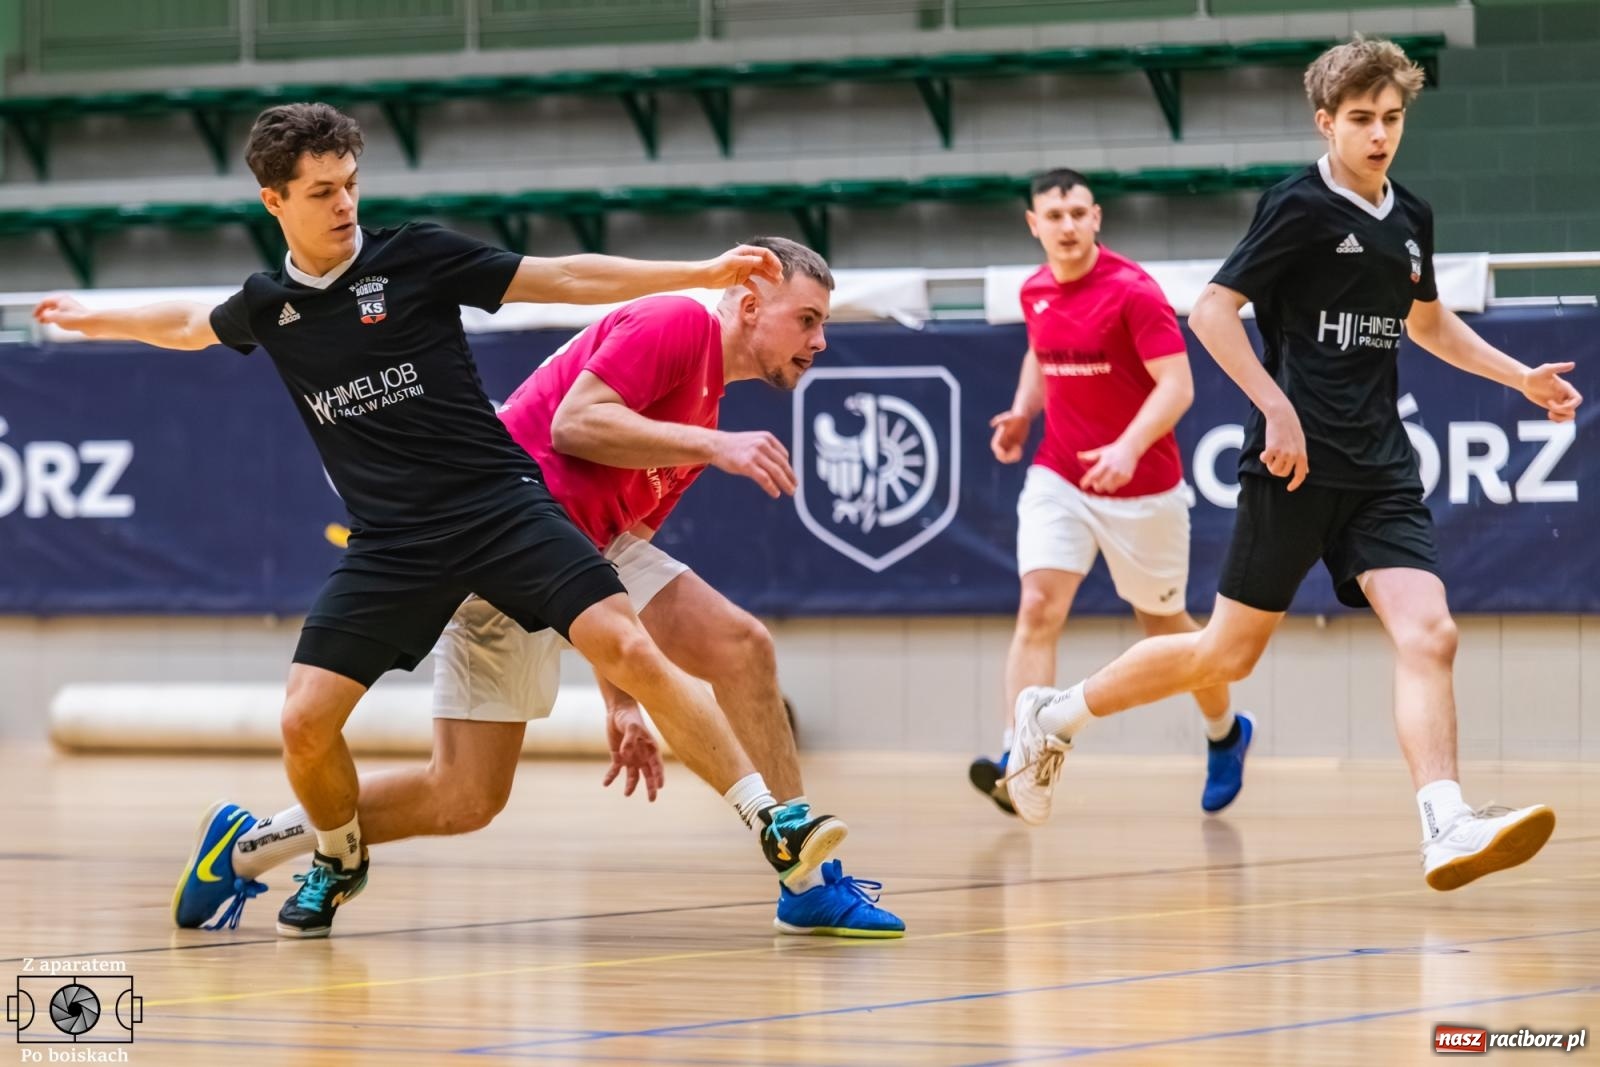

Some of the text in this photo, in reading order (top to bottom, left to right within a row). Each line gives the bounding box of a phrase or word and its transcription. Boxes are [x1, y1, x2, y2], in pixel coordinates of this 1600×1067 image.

[361, 302, 383, 315] KS
[1317, 310, 1353, 351] HJ
[365, 398, 379, 412] W
[381, 383, 424, 408] AUSTRII
